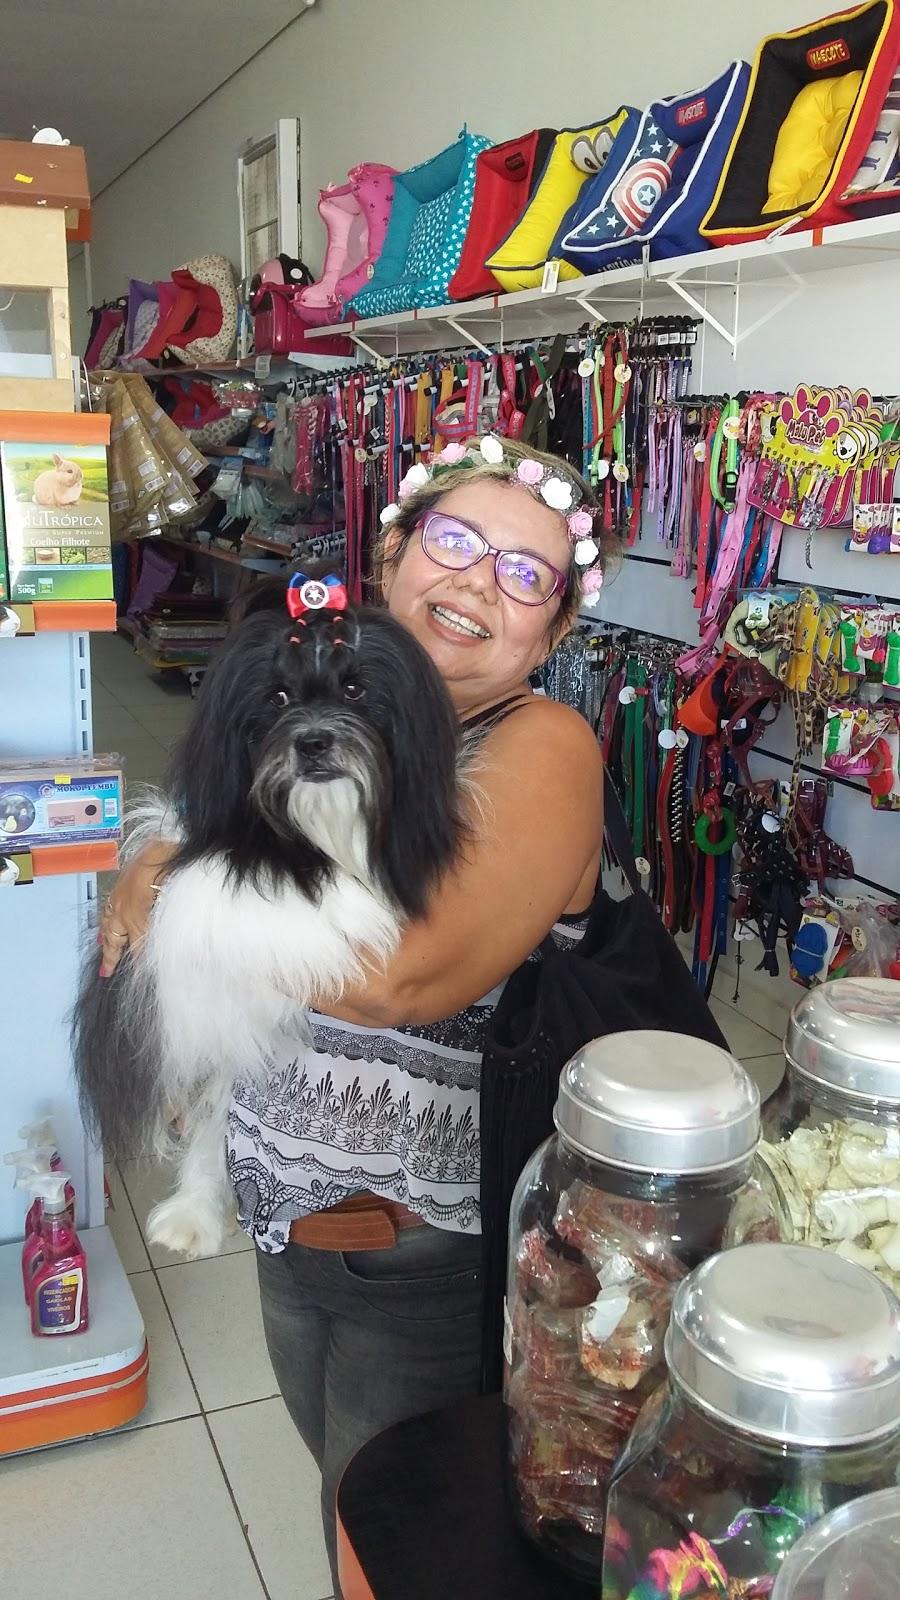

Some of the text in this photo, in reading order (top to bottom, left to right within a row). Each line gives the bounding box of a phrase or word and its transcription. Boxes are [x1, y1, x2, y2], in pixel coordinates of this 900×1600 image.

[30, 537, 91, 546] Coelho Filhote
[17, 587, 36, 596] 500g
